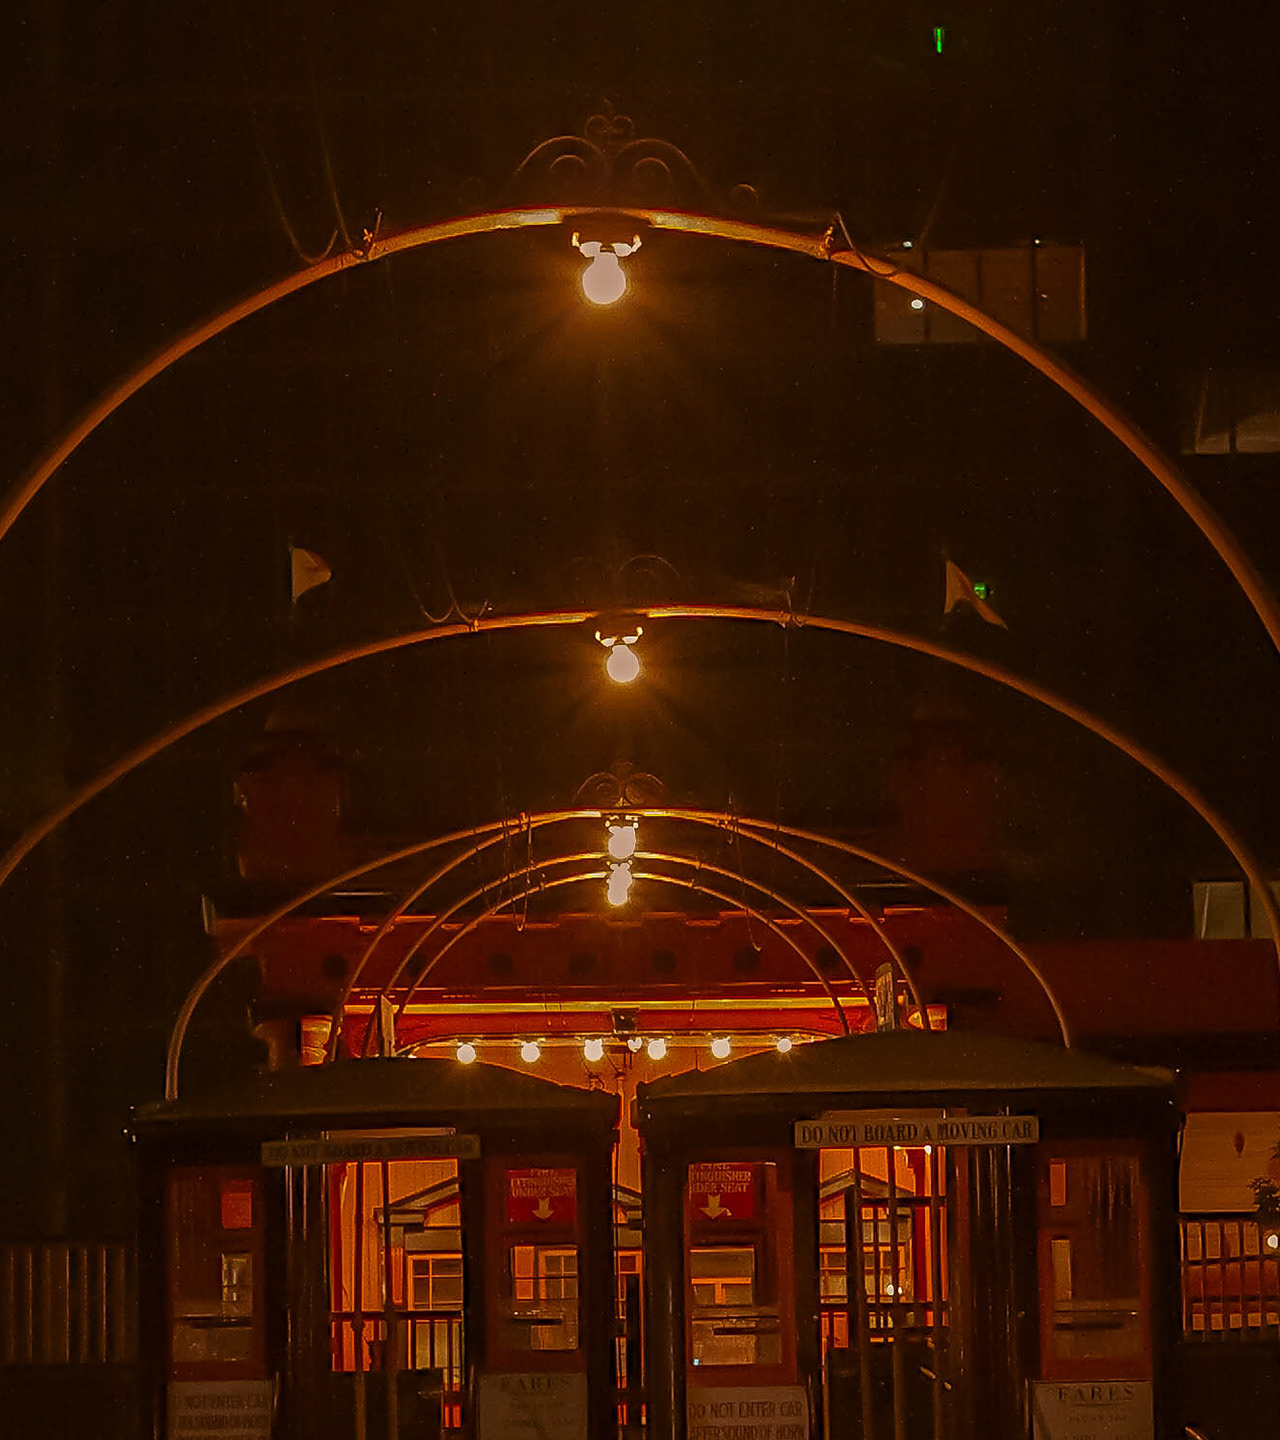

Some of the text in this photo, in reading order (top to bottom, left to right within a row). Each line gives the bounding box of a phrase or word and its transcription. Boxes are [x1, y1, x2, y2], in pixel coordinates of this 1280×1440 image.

[802, 1121, 1032, 1144] DO NOT BOARD A MOVING CAR
[720, 1181, 750, 1193] SEAT
[1057, 1385, 1135, 1401] FARES
[688, 1400, 804, 1418] DO NOT ENTER CAR
[722, 1425, 758, 1440] SOUND
[760, 1424, 772, 1440] OF
[776, 1423, 805, 1440] HORN
